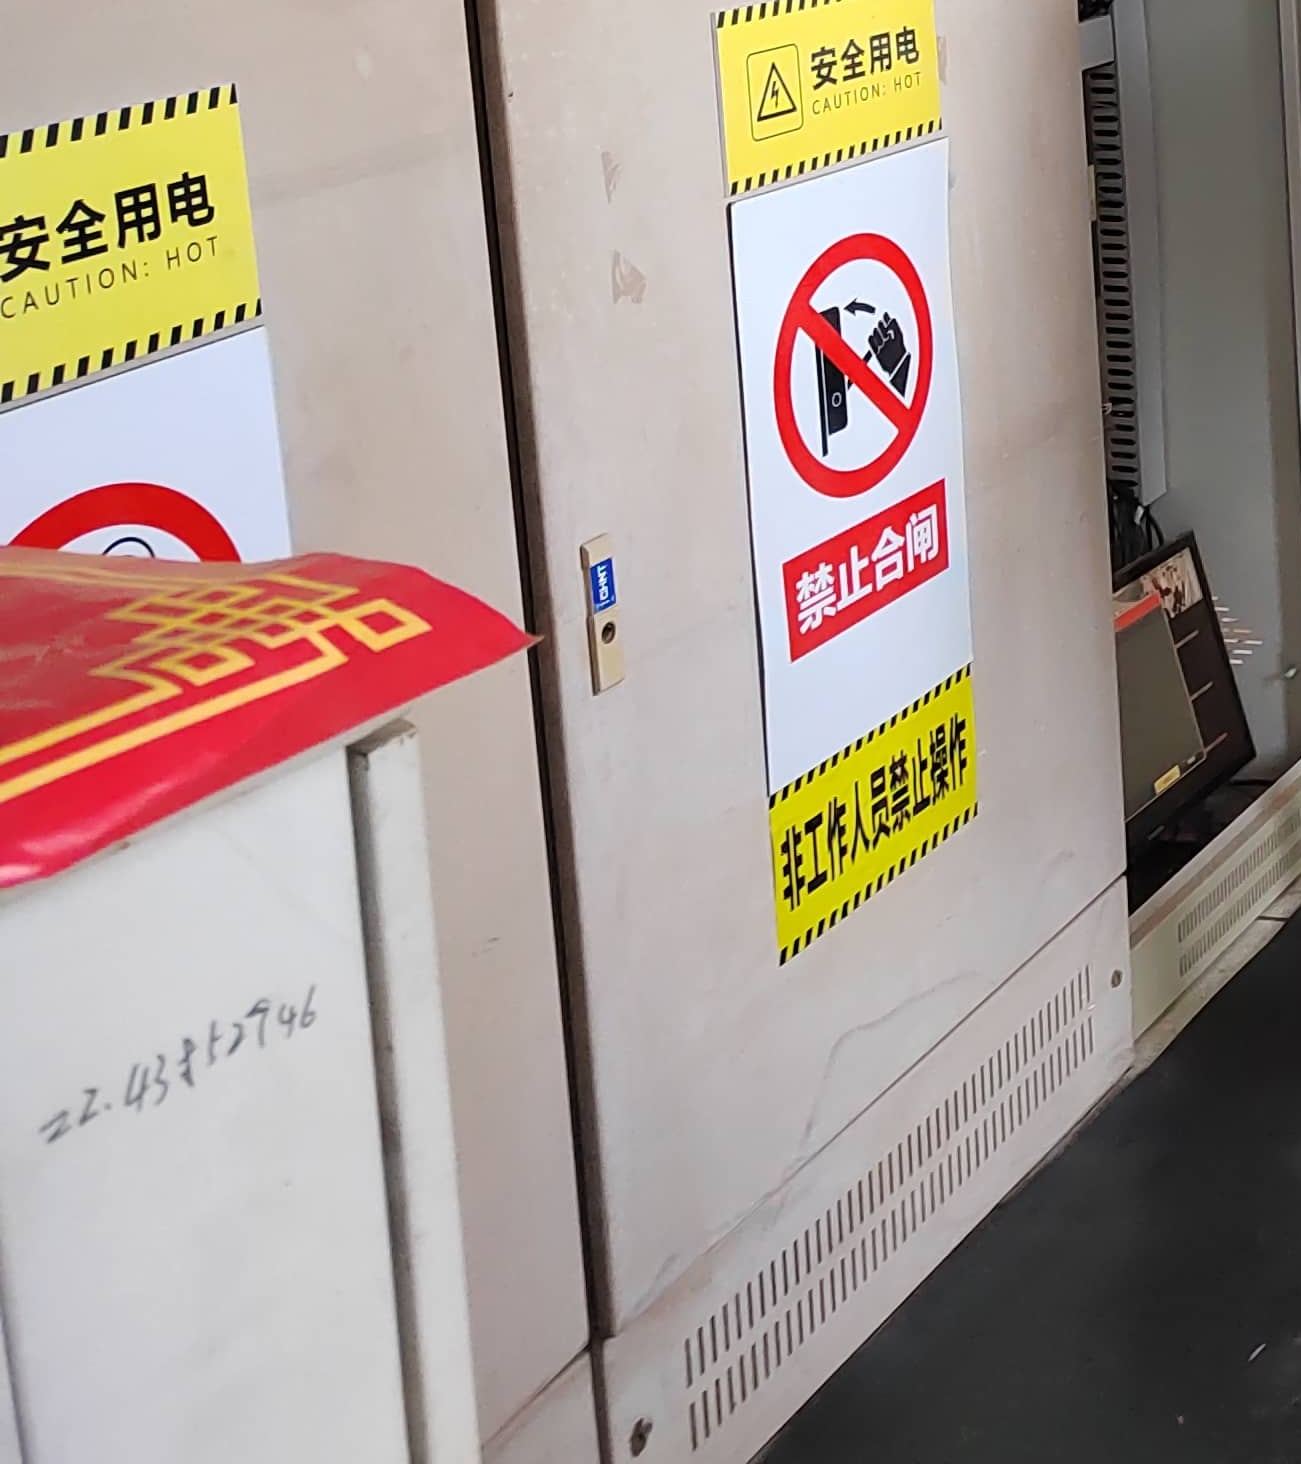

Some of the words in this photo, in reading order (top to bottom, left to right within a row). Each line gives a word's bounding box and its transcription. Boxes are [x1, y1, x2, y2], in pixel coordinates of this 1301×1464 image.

[810, 26, 919, 91] 安全用电
[812, 83, 887, 115] CAUTION:
[893, 71, 922, 93] HOT
[0, 172, 215, 283] 安全用电
[0, 259, 150, 319] CAUTION:
[166, 235, 218, 270] HOT
[795, 503, 939, 635] 禁止合闸
[780, 711, 968, 913] 非工作人员禁止操作
